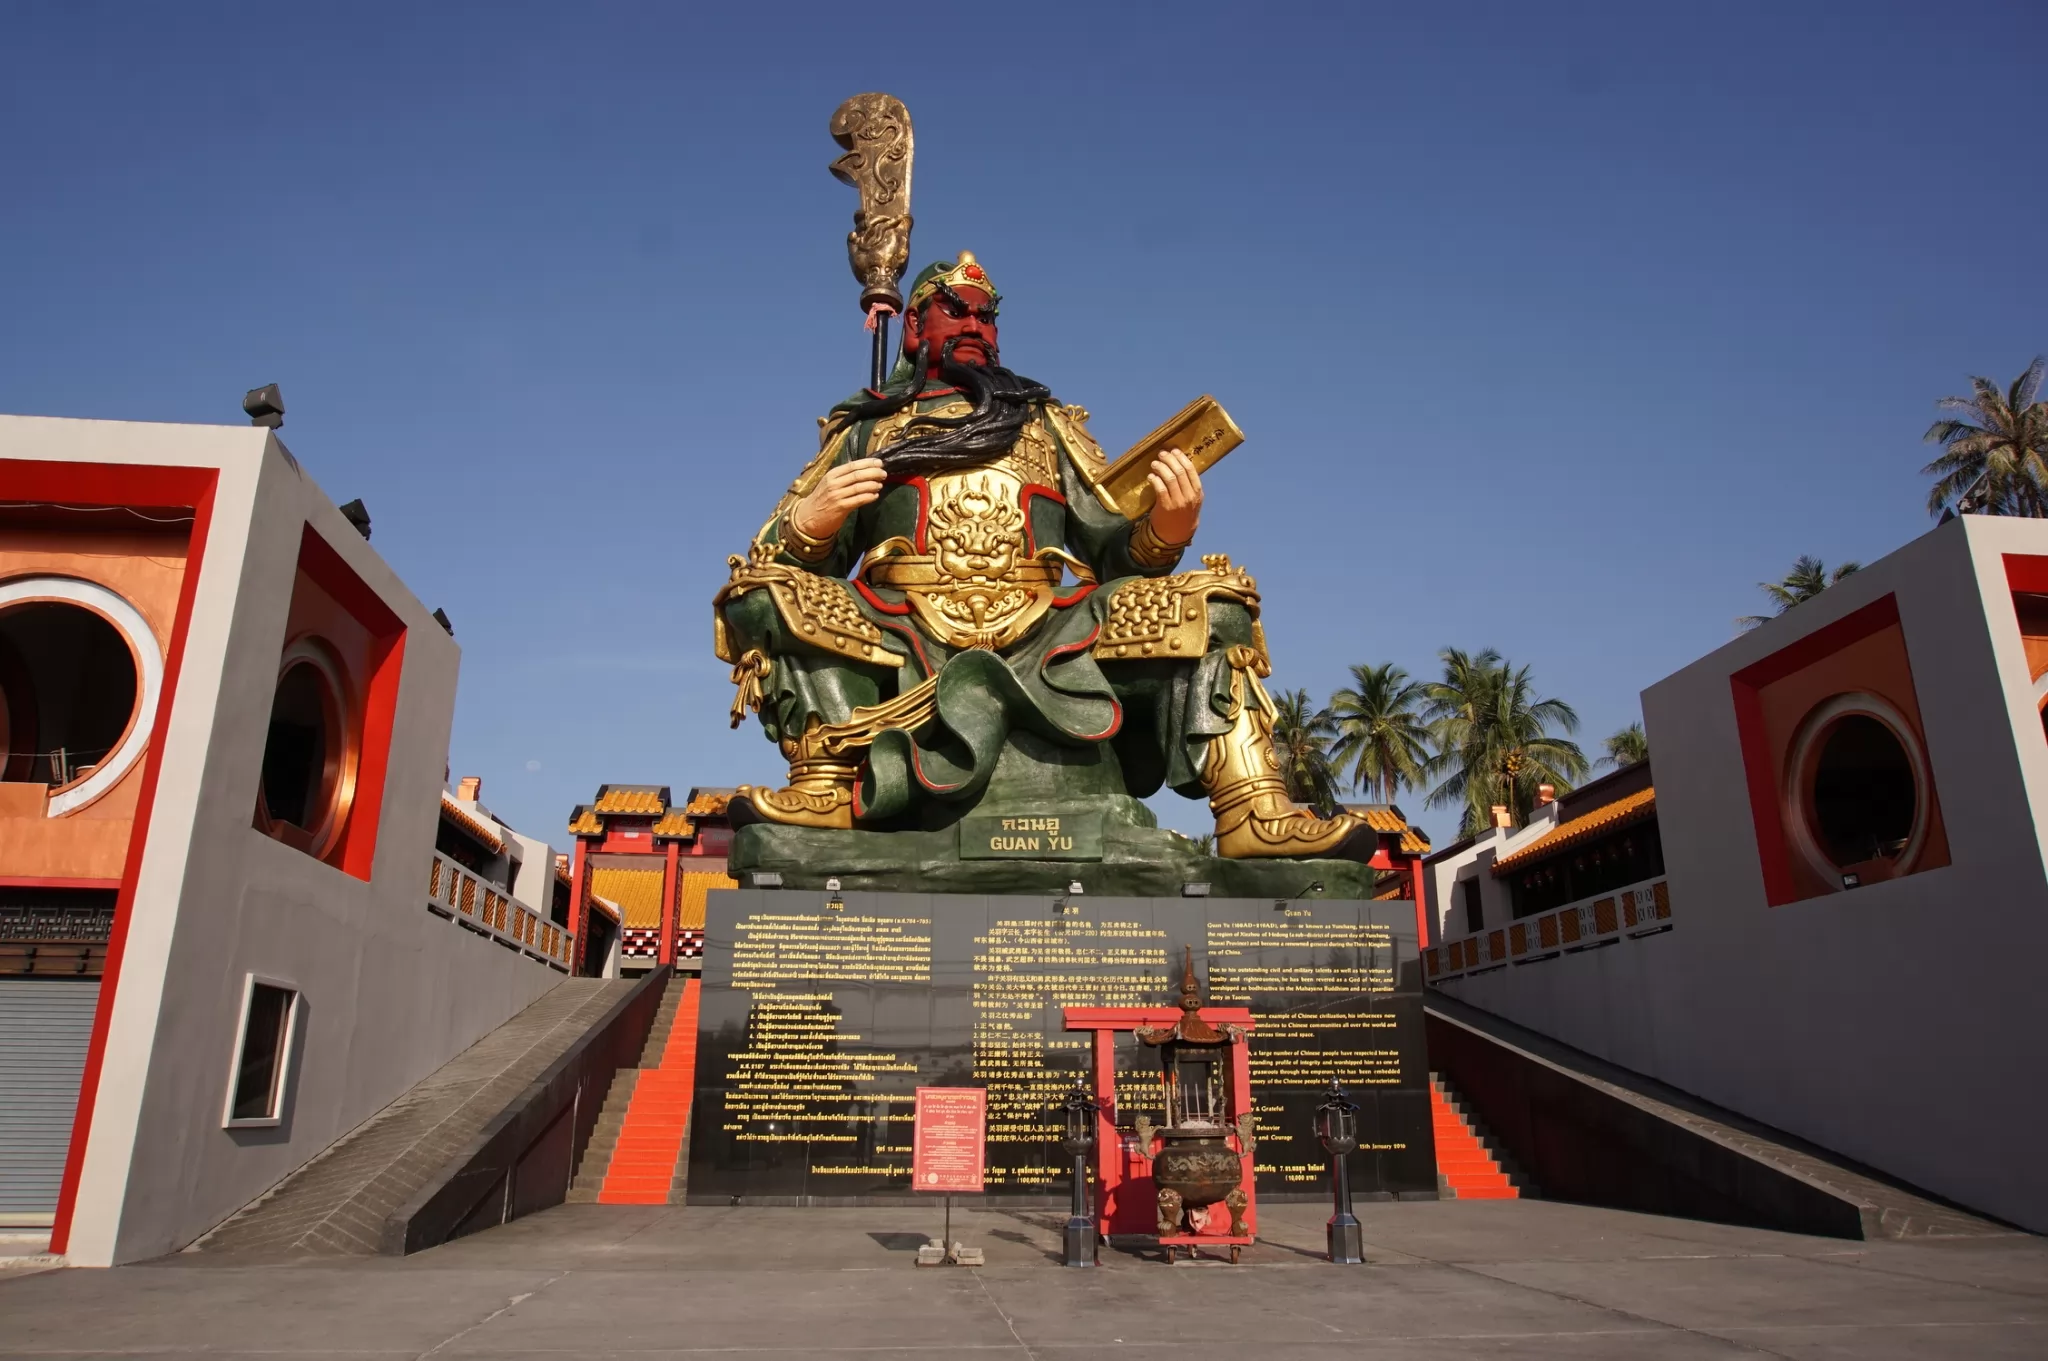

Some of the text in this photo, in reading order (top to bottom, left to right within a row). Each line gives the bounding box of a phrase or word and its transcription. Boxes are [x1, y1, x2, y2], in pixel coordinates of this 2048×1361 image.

[1002, 818, 1060, 836] กวนอู
[990, 836, 1073, 850] GUAN YU
